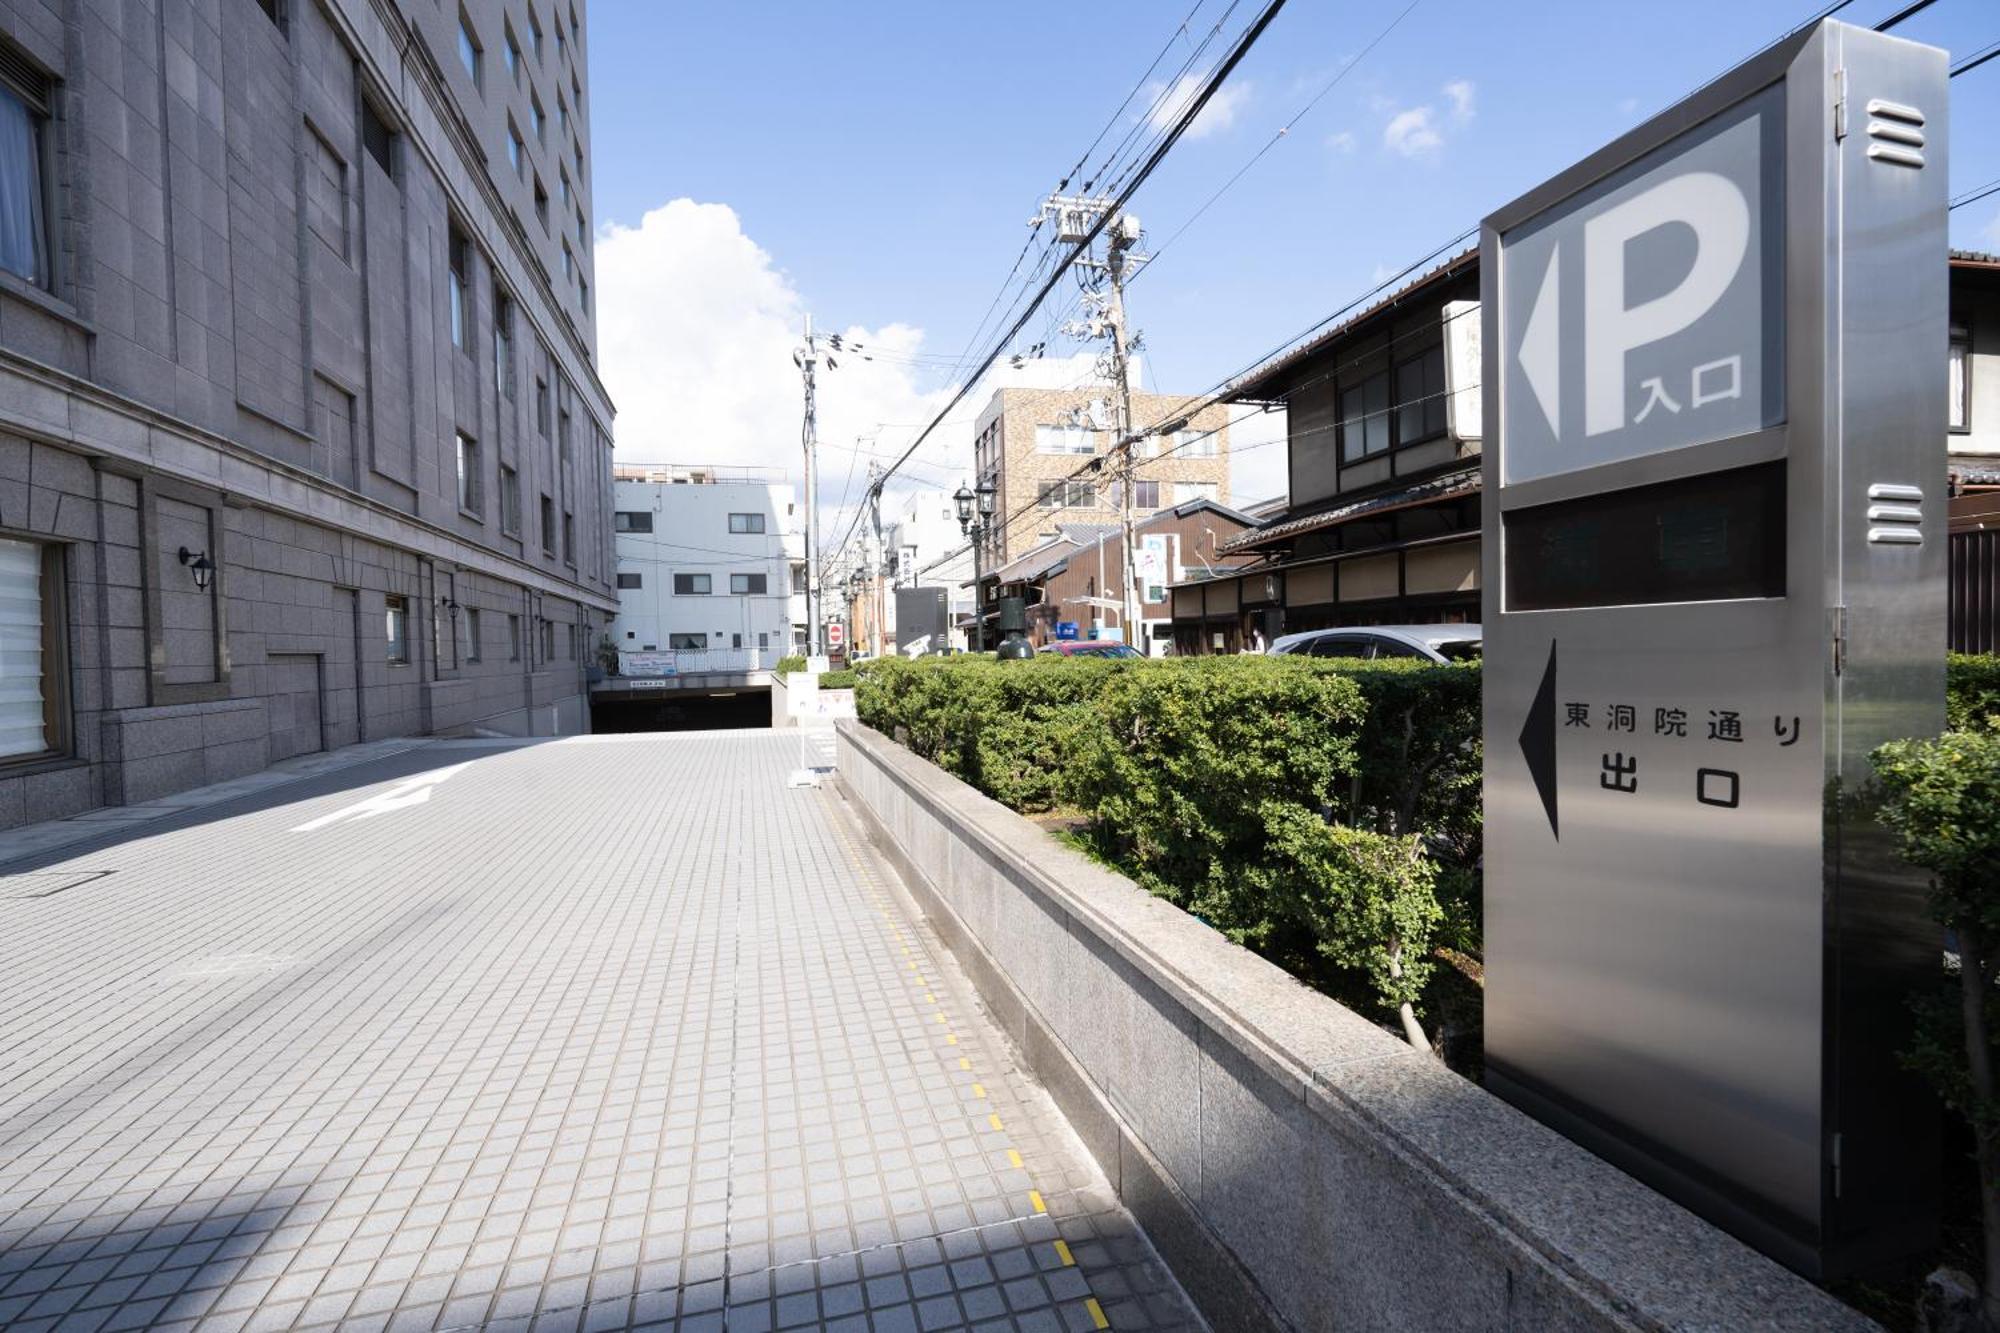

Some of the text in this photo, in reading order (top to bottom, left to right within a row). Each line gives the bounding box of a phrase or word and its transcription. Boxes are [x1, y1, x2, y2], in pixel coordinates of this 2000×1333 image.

[1585, 172, 1750, 437] P
[1634, 355, 1742, 424] 入口
[1565, 702, 1800, 746] 東洞院通り
[1601, 752, 1739, 808] 出口
